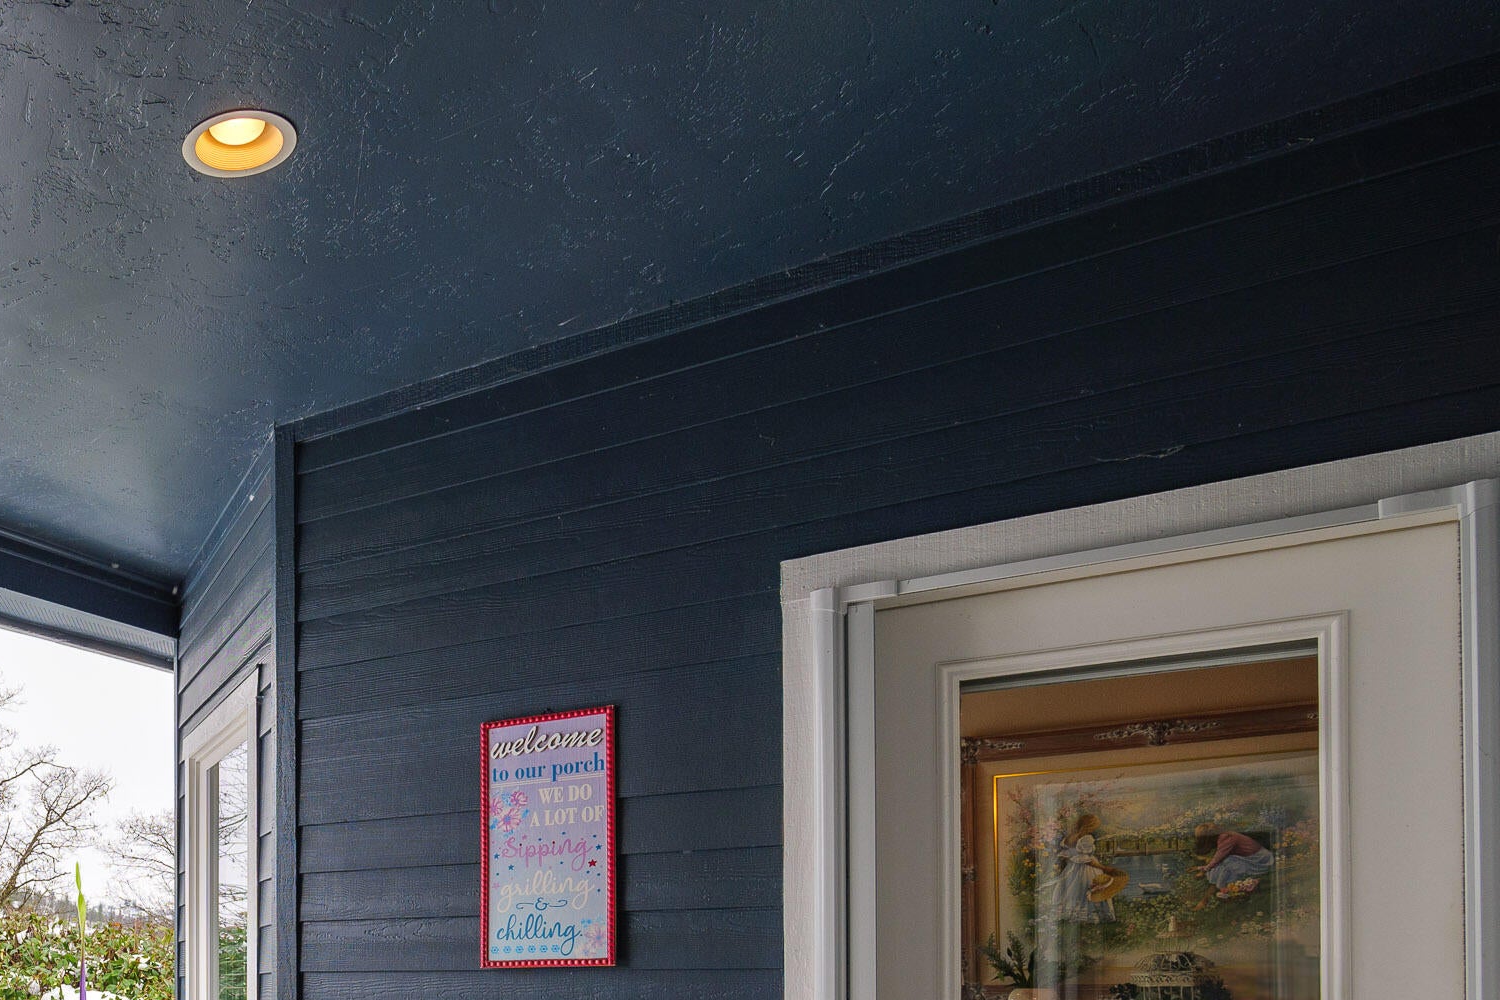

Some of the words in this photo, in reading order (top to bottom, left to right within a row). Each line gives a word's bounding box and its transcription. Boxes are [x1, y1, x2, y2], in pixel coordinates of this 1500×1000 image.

[490, 725, 603, 760] welcome
[492, 768, 509, 782] to
[515, 765, 546, 779] our
[551, 752, 605, 782] porch
[538, 786, 564, 804] WE
[568, 783, 592, 802] DO
[529, 813, 540, 827] A
[545, 808, 577, 826] LOT
[581, 805, 605, 823] OF
[501, 836, 593, 871] Sipping
[496, 870, 595, 913] grilling
